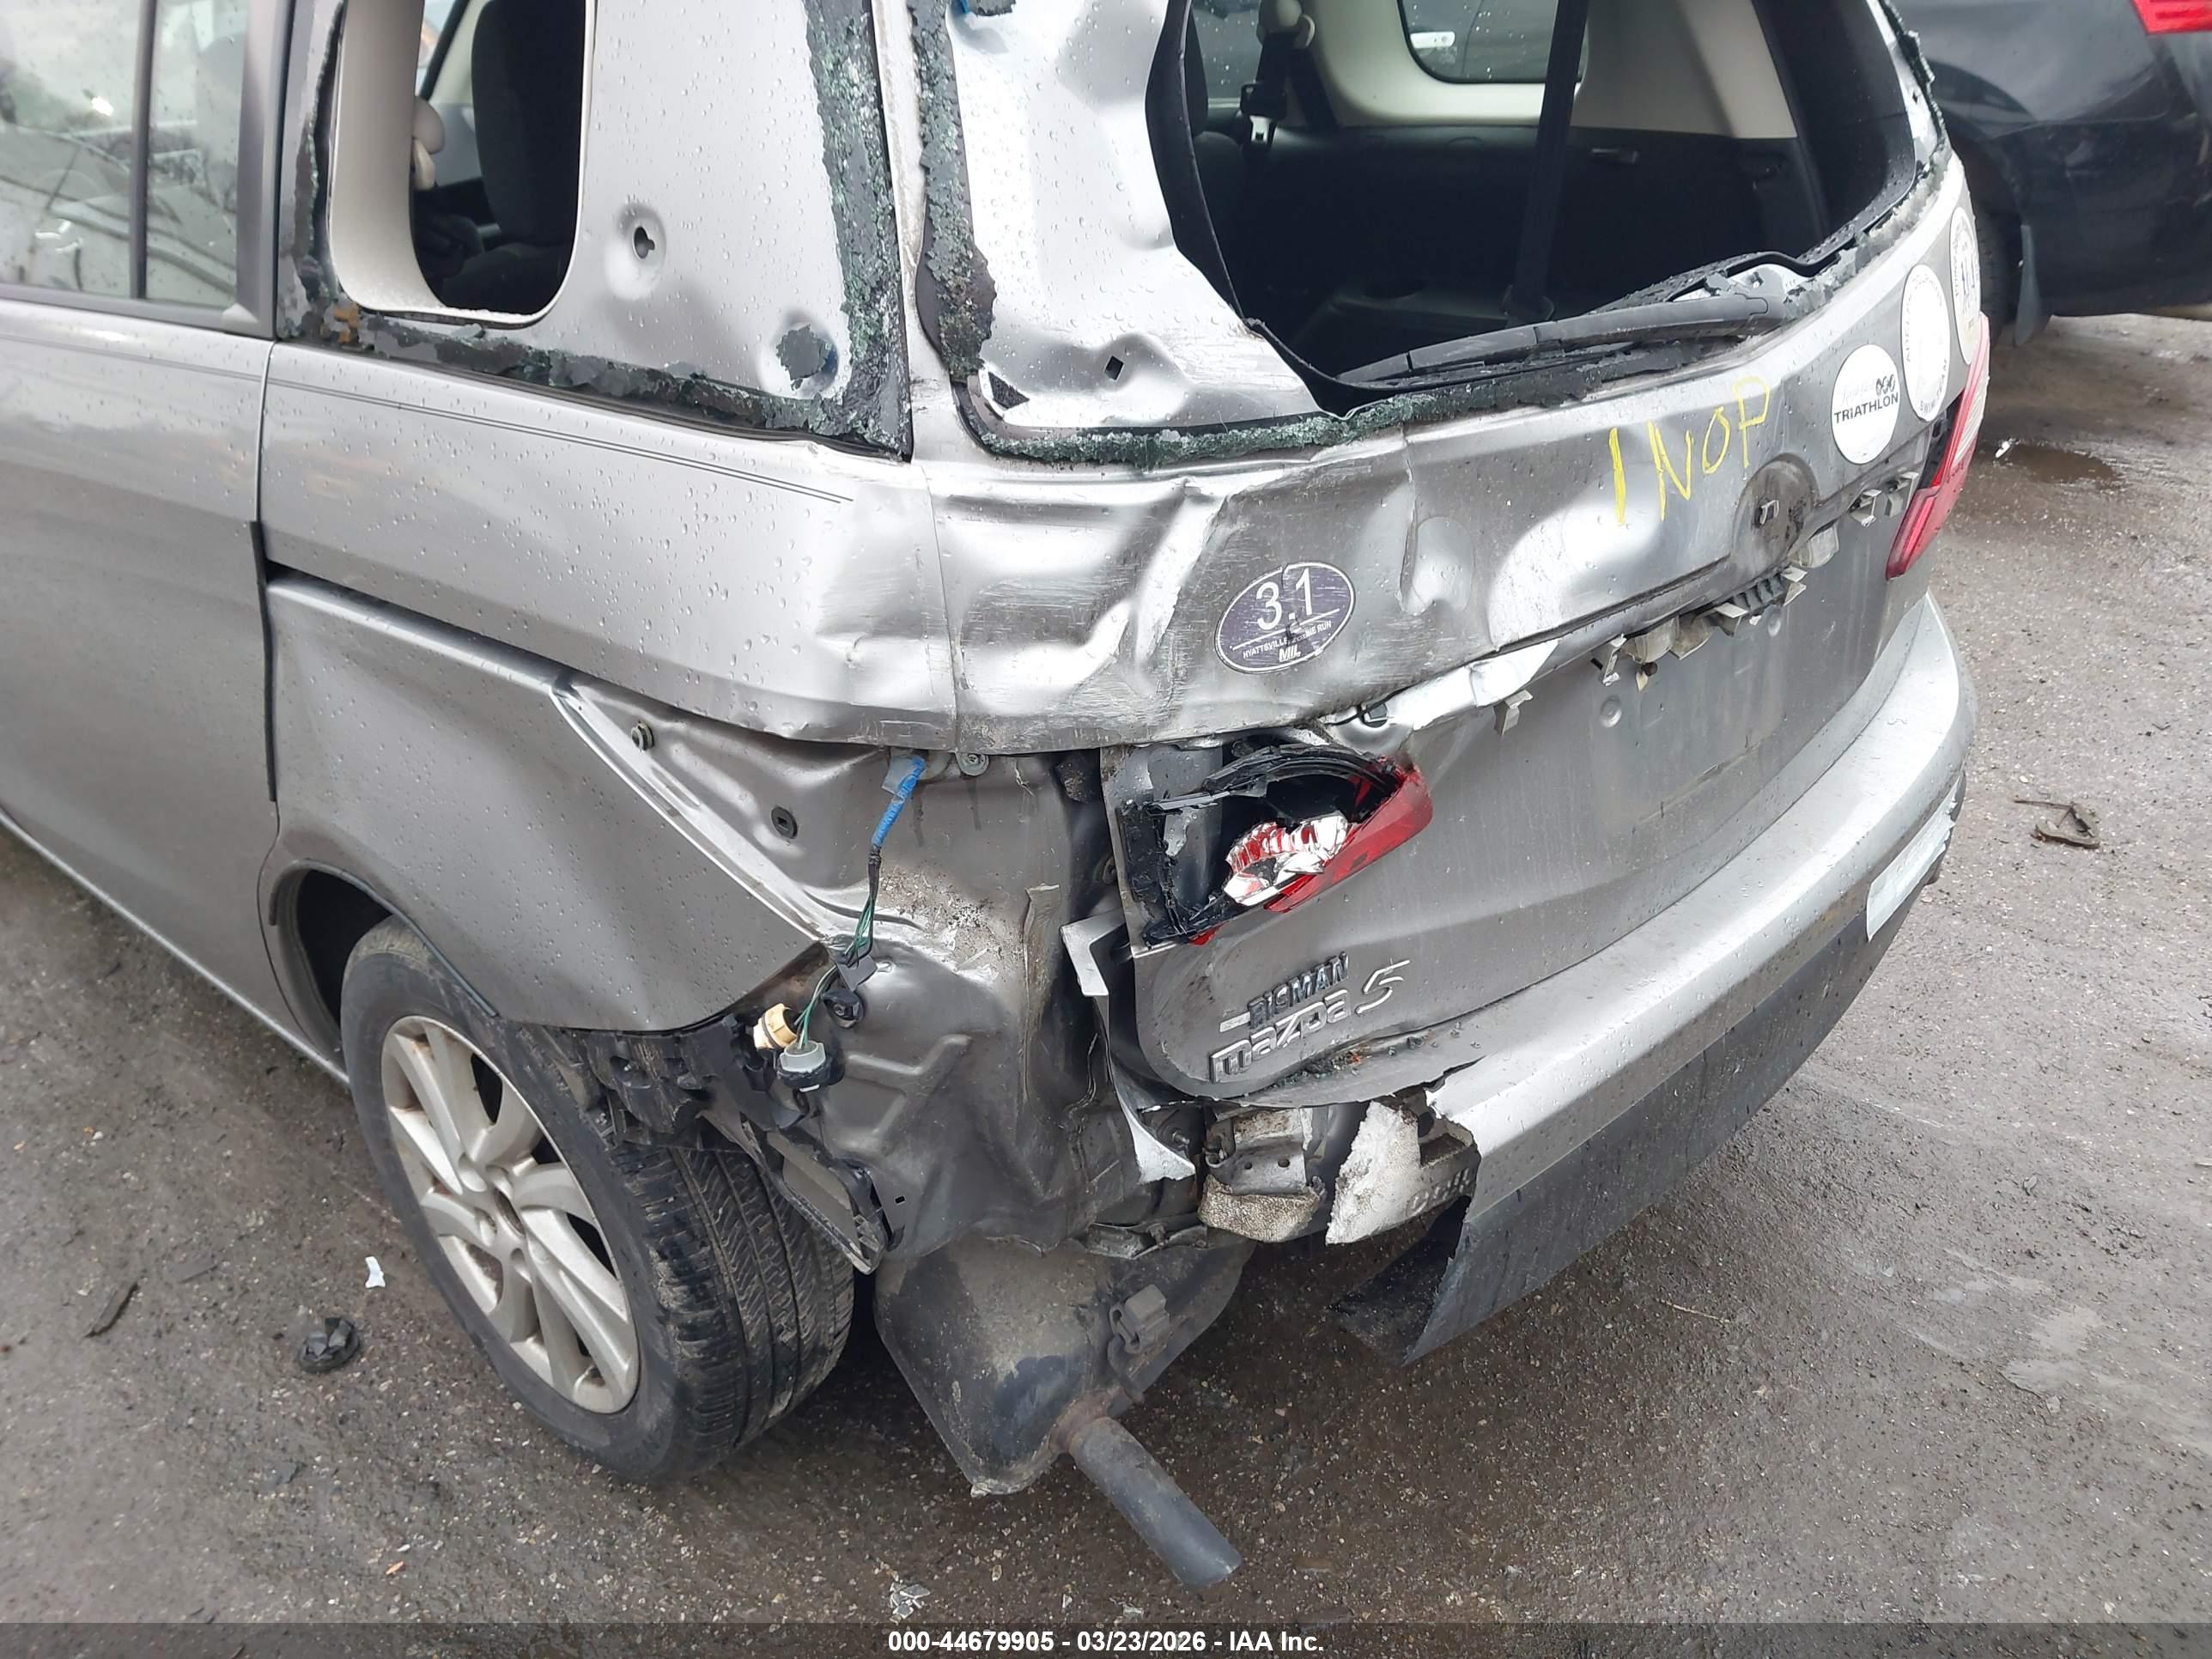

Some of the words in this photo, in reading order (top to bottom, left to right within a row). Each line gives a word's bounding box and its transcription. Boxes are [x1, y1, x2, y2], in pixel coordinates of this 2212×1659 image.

[1833, 391, 1899, 424] TRIATHLON
[1256, 568, 1313, 630] 3.1
[1243, 637, 1289, 659] HYATTSVILLE
[1317, 620, 1332, 633] RUN
[1355, 959, 1410, 1014] 5
